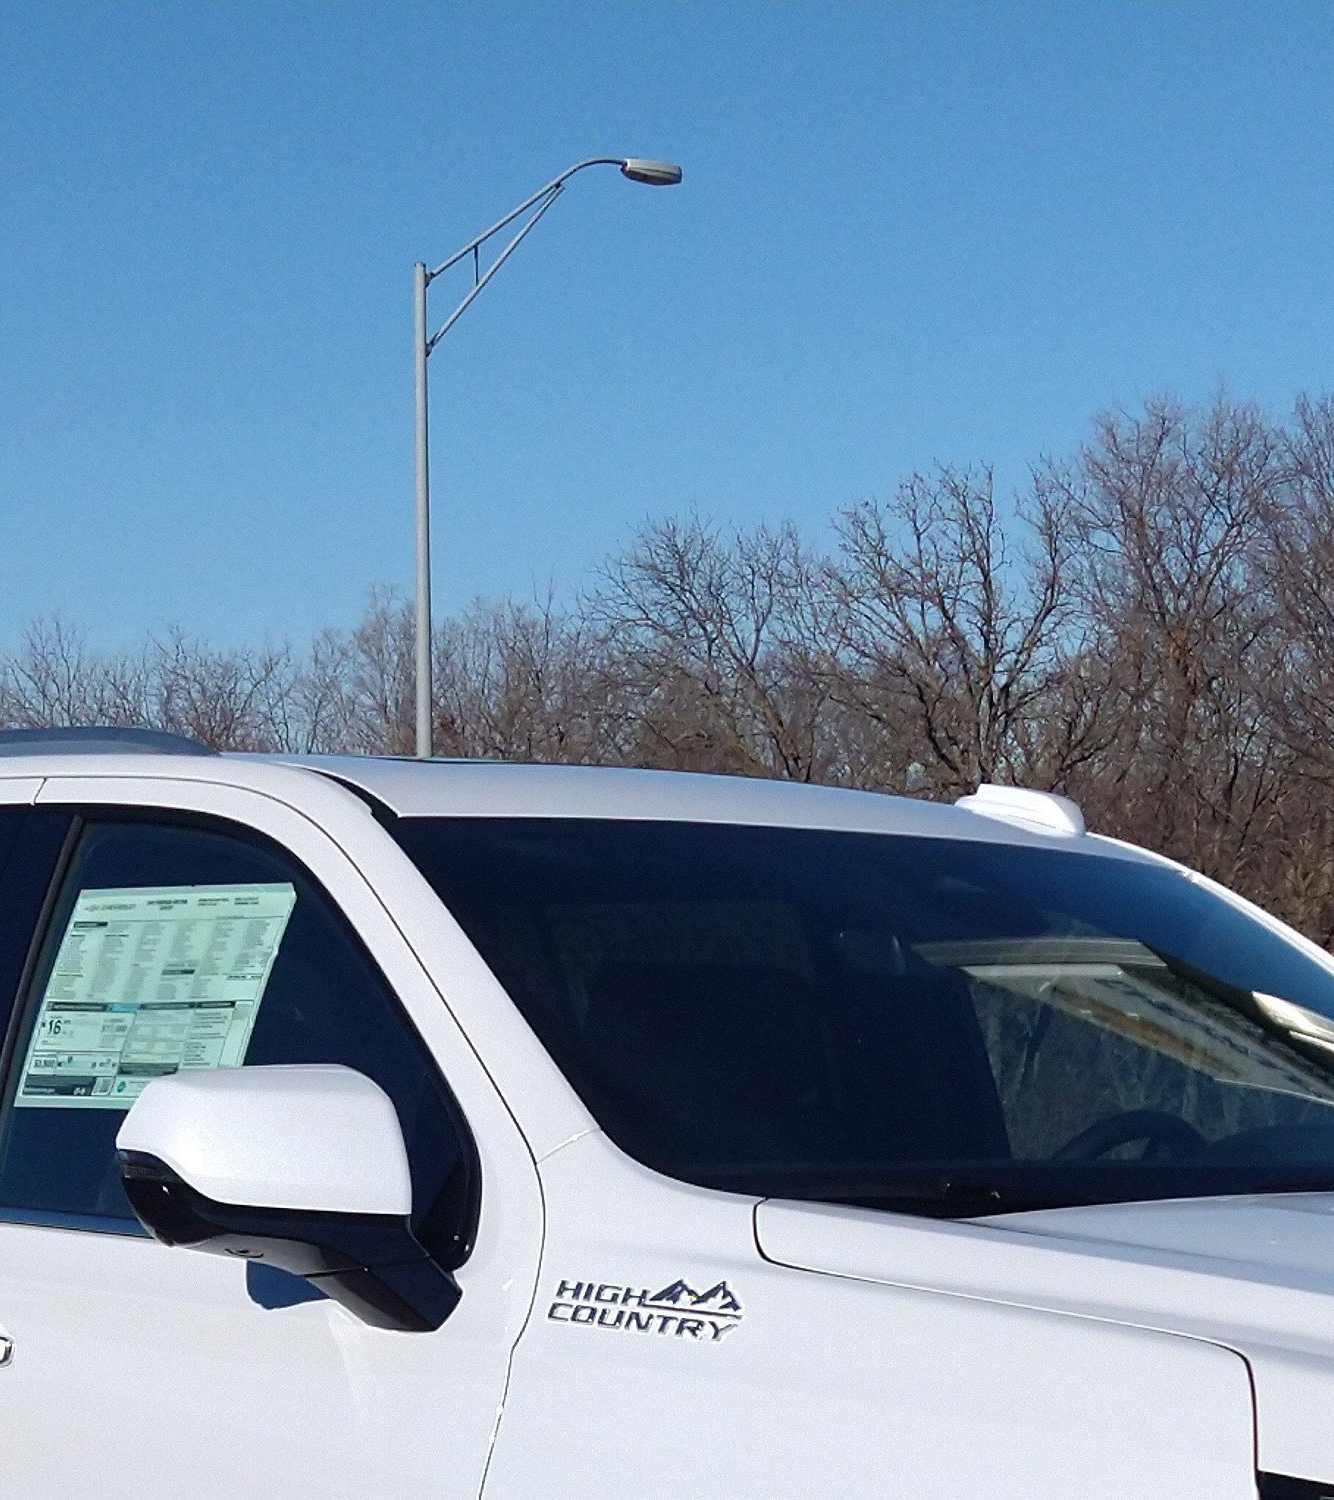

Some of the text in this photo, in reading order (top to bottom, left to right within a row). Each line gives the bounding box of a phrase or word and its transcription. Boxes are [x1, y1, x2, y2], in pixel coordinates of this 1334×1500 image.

[48, 1019, 62, 1035] 16
[555, 1279, 650, 1306] HIGH
[547, 1303, 737, 1340] COUNTRY
